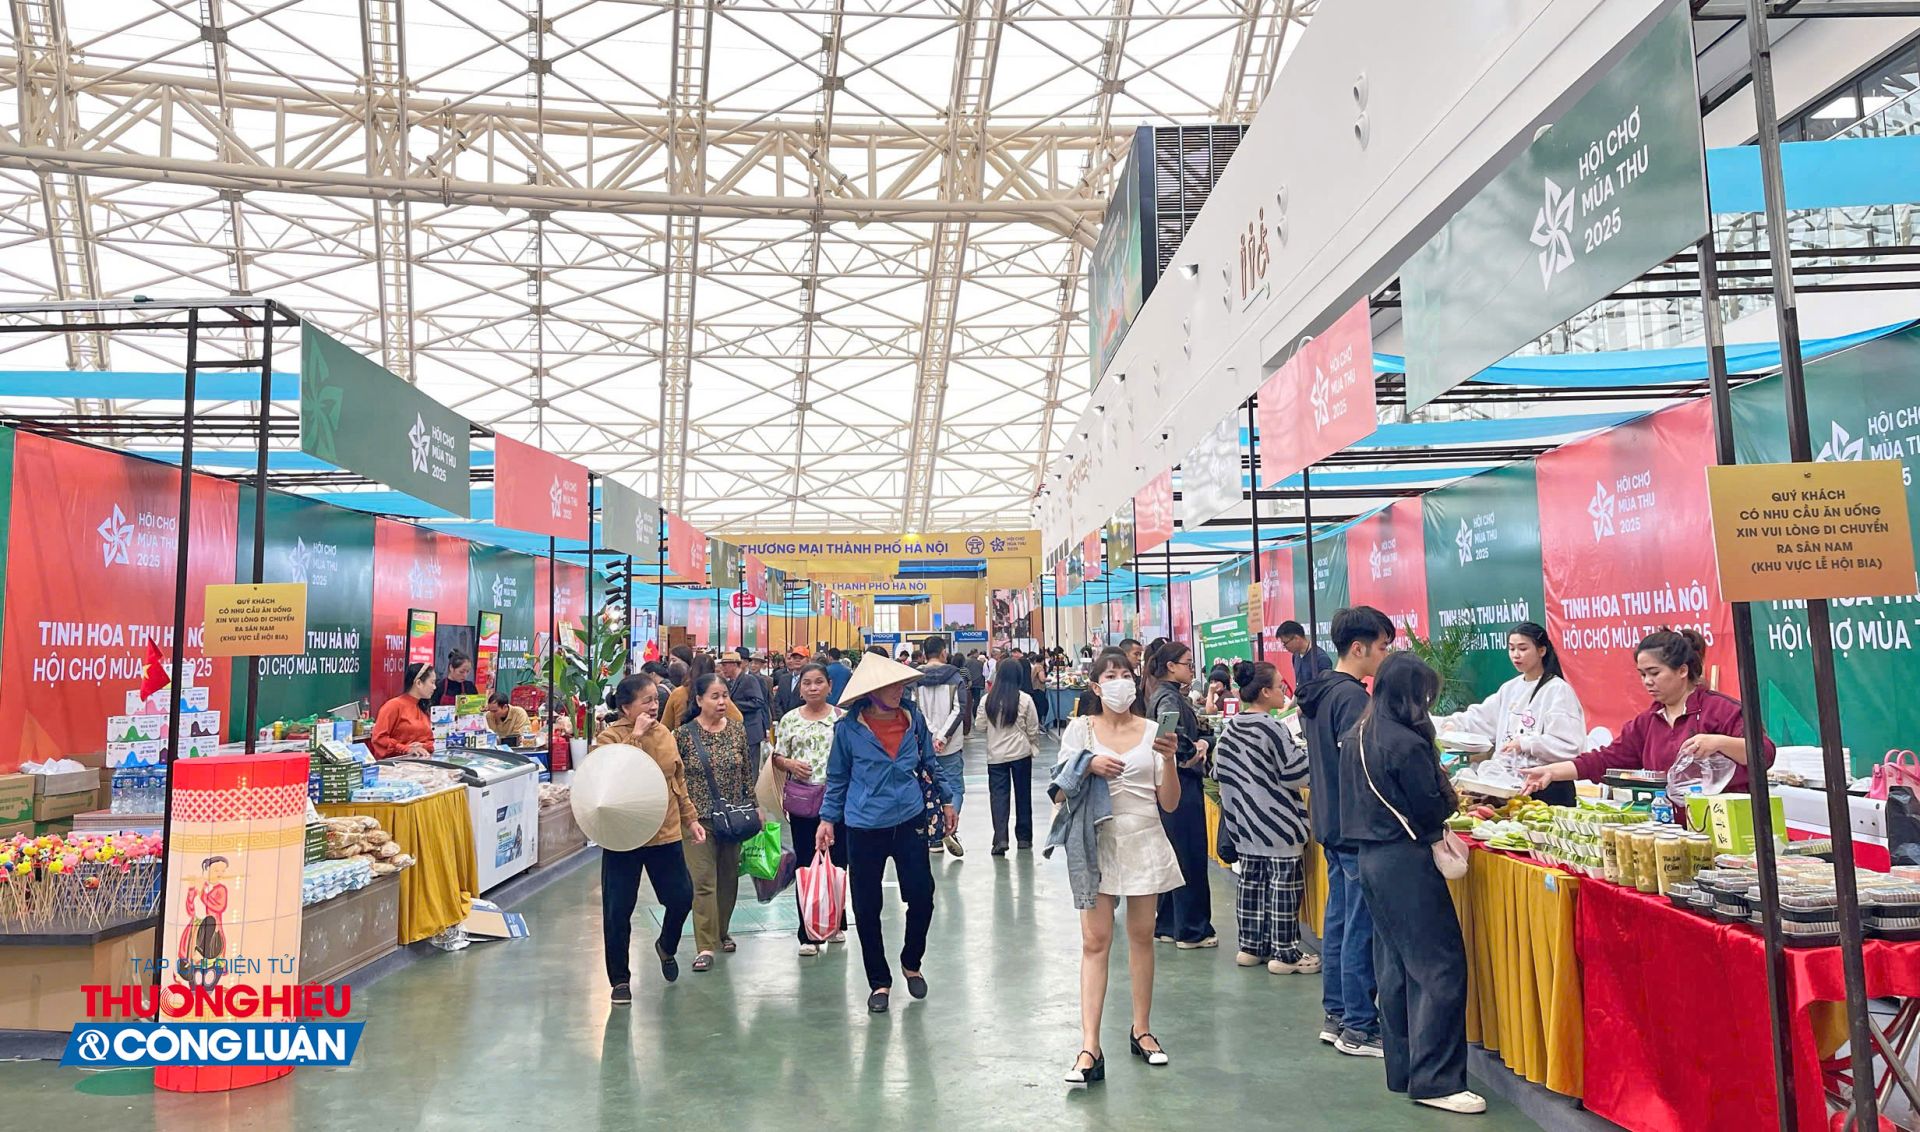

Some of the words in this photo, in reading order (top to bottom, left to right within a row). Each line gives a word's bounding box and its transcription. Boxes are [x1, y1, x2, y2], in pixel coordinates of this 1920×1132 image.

[1579, 140, 1604, 181] HỘI
[1606, 105, 1640, 156] CHỢ
[1582, 174, 1615, 217] MÙA
[1616, 145, 1649, 188] THU
[1584, 207, 1622, 254] 2025
[1868, 411, 1894, 437] HỘI
[1896, 405, 1920, 428] CH
[1870, 438, 1904, 460] MÙA
[432, 464, 447, 482] 2025
[1637, 492, 1655, 508] THU
[1771, 489, 1797, 502] QUÝ
[1801, 488, 1846, 501] KHÁCH
[138, 512, 155, 528] HỘI
[1739, 508, 1760, 520] CÓ
[1763, 510, 1789, 520] NHU
[1792, 503, 1820, 519] CẦU
[1823, 505, 1841, 517] ĂN
[1844, 502, 1881, 517] UỐNG
[1620, 517, 1640, 533] 2025
[1736, 528, 1758, 538] XIN
[1761, 527, 1782, 537] VUI
[1785, 523, 1820, 536] LÒNG
[1840, 518, 1889, 534] CHUYỂN
[799, 544, 823, 557] MẠI
[826, 541, 871, 554] THÀNH
[874, 539, 902, 554] PHỐ
[904, 540, 923, 553] HÀ
[925, 540, 948, 556] NỘI
[1475, 547, 1489, 560] 2025
[1776, 544, 1793, 554] RA
[1796, 541, 1821, 553] SÂN
[1825, 541, 1853, 552] NAM
[137, 553, 160, 567] 2025
[1751, 562, 1782, 574] (KHU
[1785, 559, 1812, 573] VỰC
[1816, 555, 1828, 569] LỄ
[1831, 558, 1854, 572] HỘI
[1857, 558, 1883, 570] BIA)
[1560, 597, 1590, 619] TINH
[1591, 594, 1620, 618] HOA
[1622, 591, 1650, 615] THU
[1653, 583, 1676, 613] HÀ
[1678, 579, 1708, 618] NỘI
[1477, 605, 1494, 625] THU
[1495, 598, 1510, 623] HÀ
[1511, 597, 1530, 622] NỘI
[38, 621, 82, 647] TINH
[86, 624, 124, 647] HOA
[128, 624, 161, 647] THU
[163, 627, 174, 648] H
[308, 631, 328, 649] THU
[329, 627, 342, 649] HÀ
[344, 628, 360, 654] NỘI
[1489, 632, 1507, 650] THU
[1562, 624, 1582, 655] HỘI
[1584, 625, 1610, 655] CHỢ
[1612, 620, 1640, 648] MÙA
[1768, 615, 1803, 658] HỘI
[1858, 611, 1912, 650] MÙA
[33, 652, 65, 688] HỘI
[69, 655, 106, 686] CHỢ
[109, 651, 144, 679] MÙA
[271, 656, 295, 679] CHỢ
[296, 652, 317, 674] MÙA
[320, 657, 337, 674] THU
[339, 657, 359, 673] 2025
